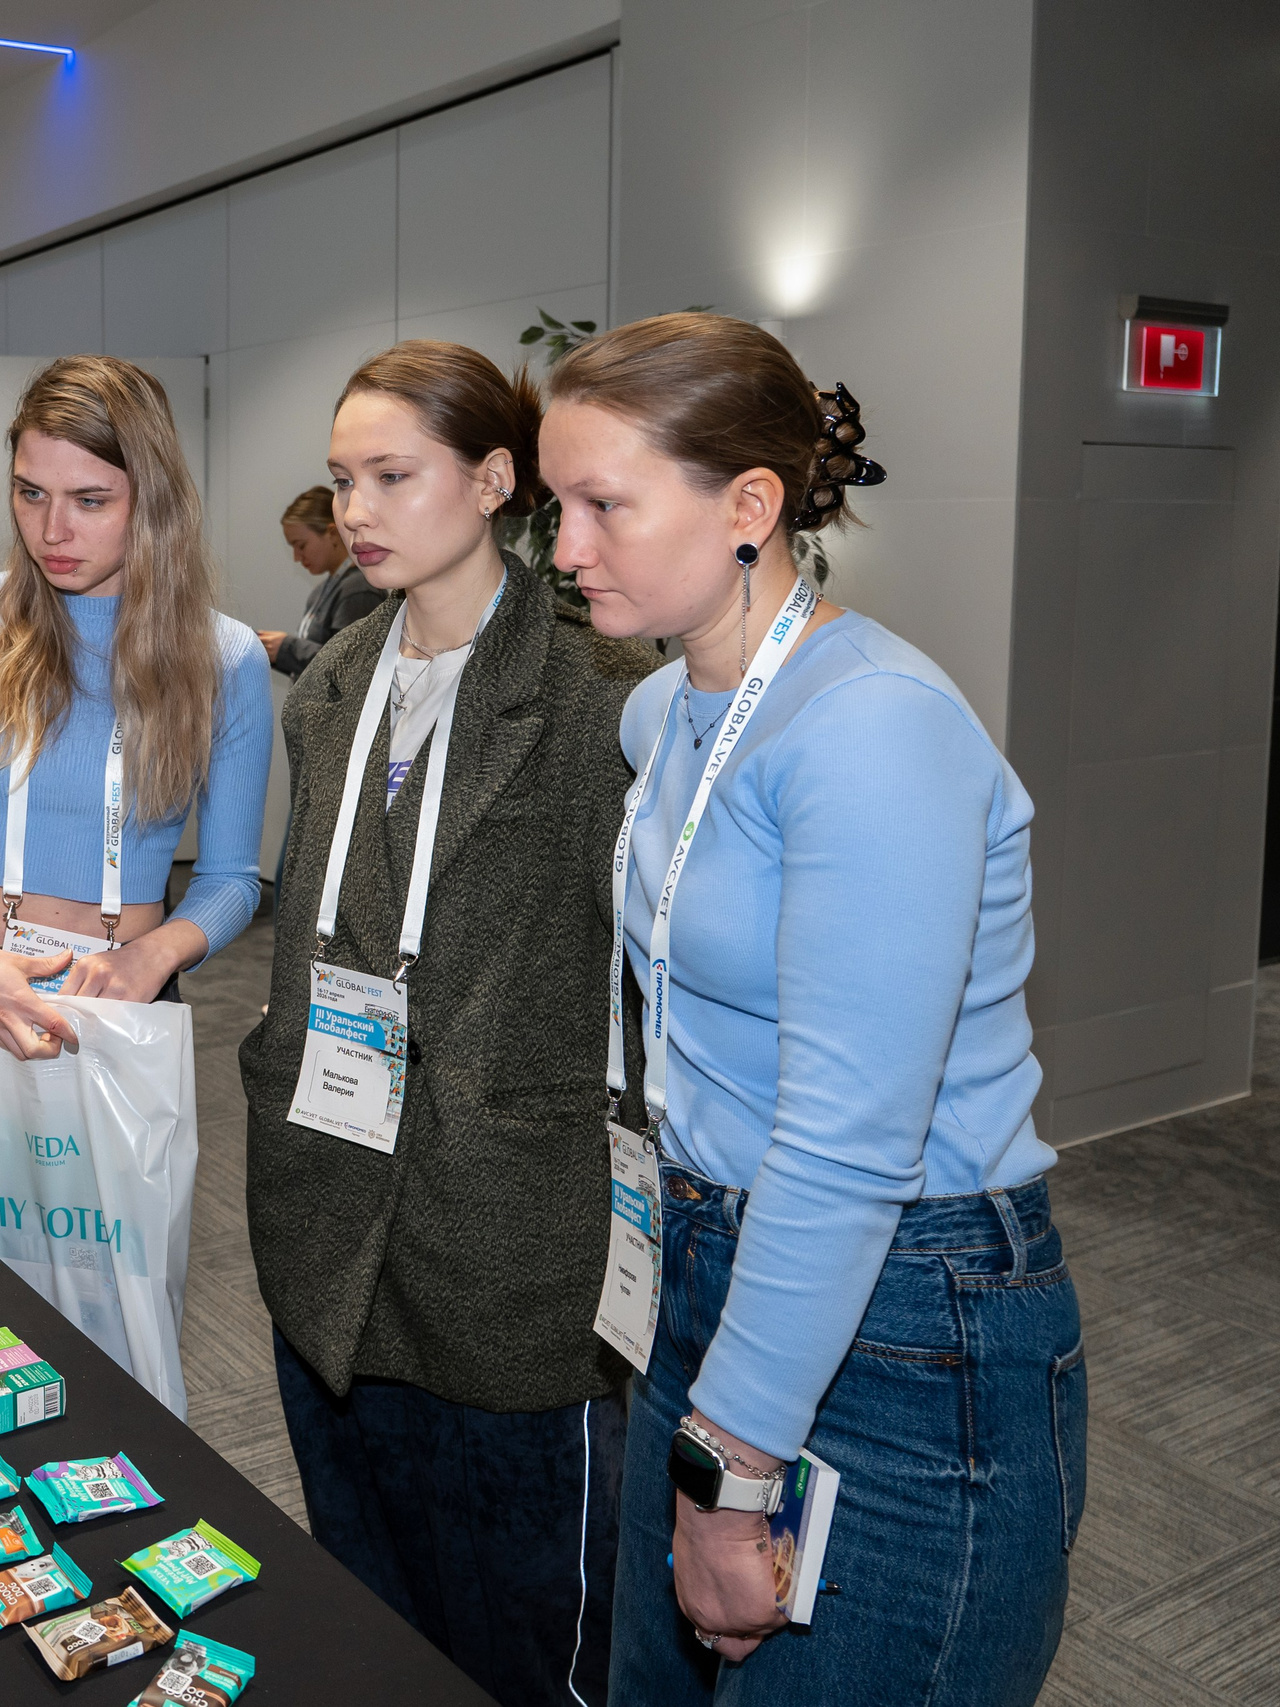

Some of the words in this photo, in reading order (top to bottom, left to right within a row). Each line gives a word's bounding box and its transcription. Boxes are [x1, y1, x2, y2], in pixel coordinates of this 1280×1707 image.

[785, 579, 810, 614] GLOBAL
[770, 615, 793, 645] FEST
[112, 781, 121, 802] FEST
[111, 805, 120, 847] GLOBAL
[36, 936, 70, 950] GLOBAL
[73, 944, 91, 954] FEST
[613, 942, 621, 997] GLOBAL
[336, 979, 365, 994] GLOBAL
[367, 987, 382, 998] FEST
[315, 1019, 368, 1042] Глобалфест
[326, 1010, 375, 1033] Уральский
[336, 1046, 373, 1062] УЧАСТНИК
[322, 1068, 359, 1086] Малькова
[322, 1081, 355, 1098] Валерия
[25, 1131, 80, 1158] VEDA
[35, 1159, 65, 1167] PREMIUM
[35, 1202, 121, 1253] TOTEM
[8, 1581, 25, 1597] DOG
[186, 1685, 207, 1699] DO
